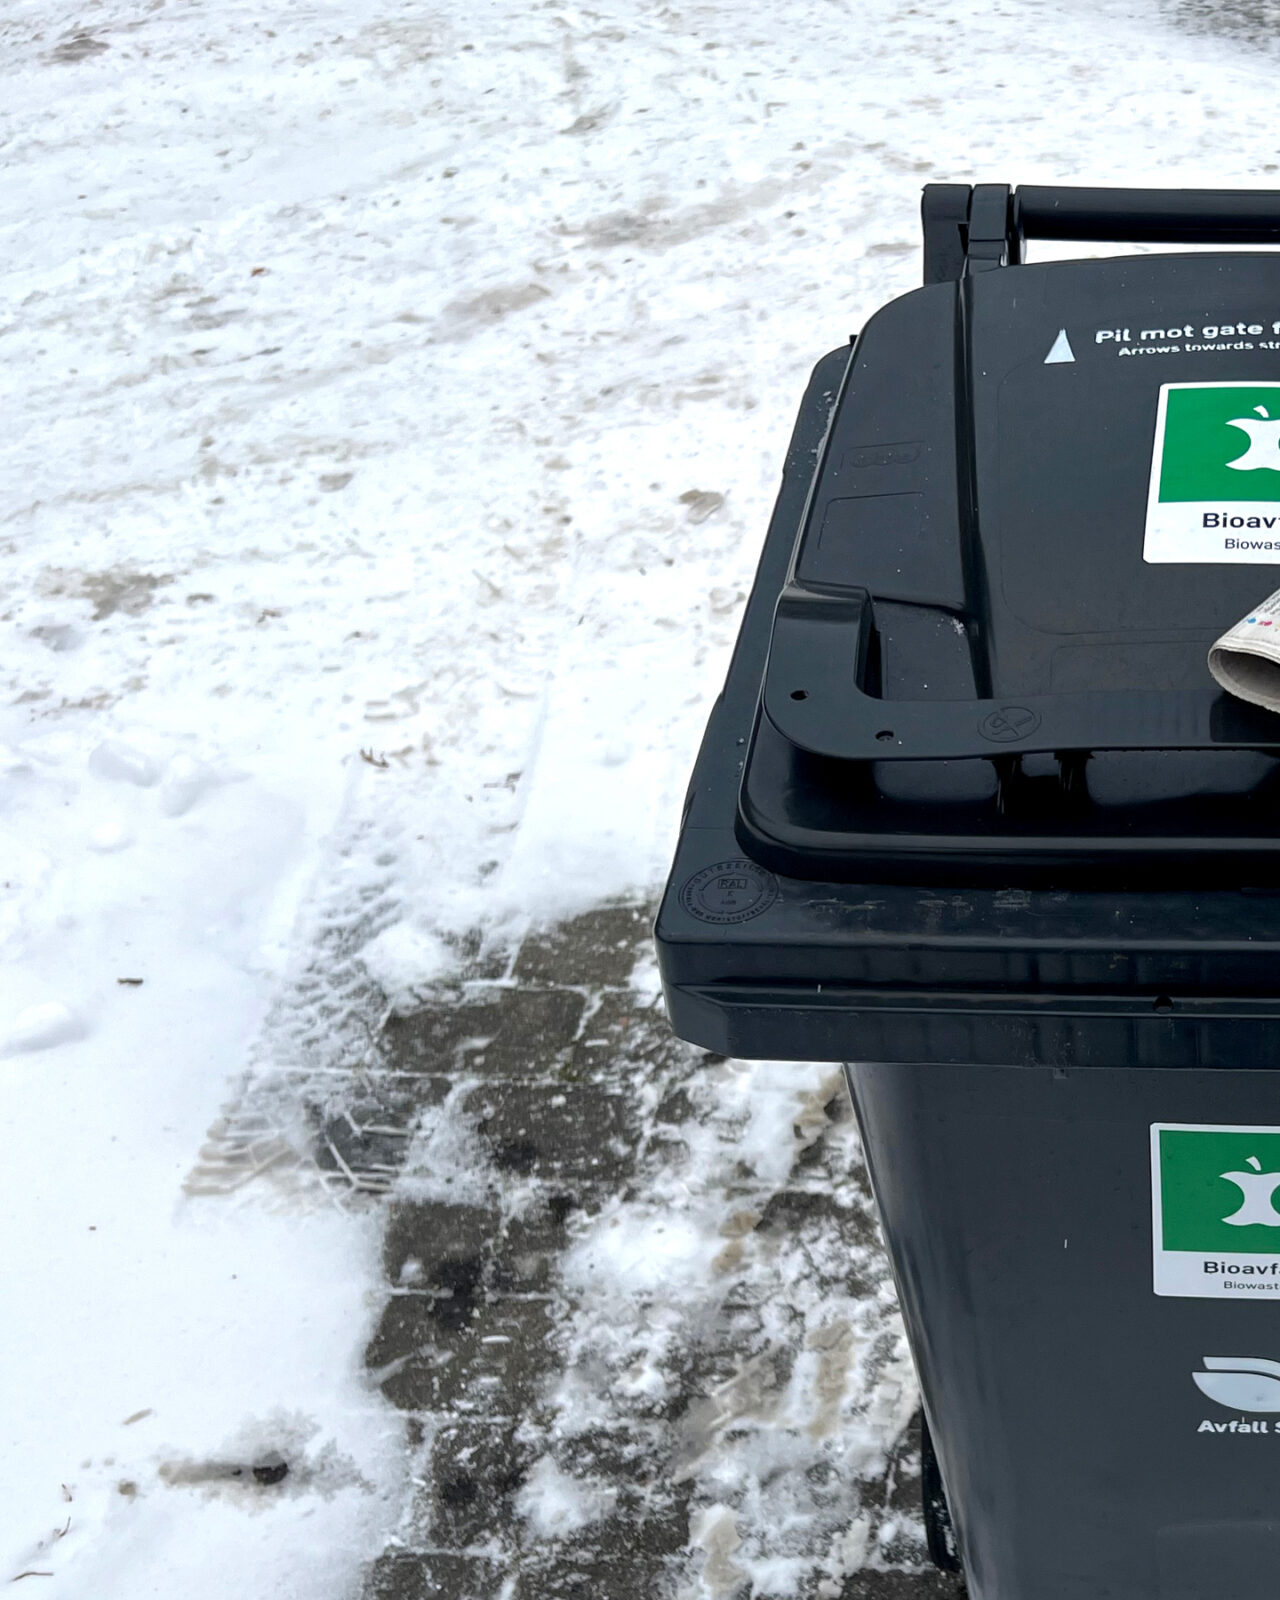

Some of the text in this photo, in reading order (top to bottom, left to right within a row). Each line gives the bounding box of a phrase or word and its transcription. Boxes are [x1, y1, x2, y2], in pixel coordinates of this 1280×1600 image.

[1095, 328, 1131, 343] Pil
[1140, 325, 1194, 341] mot
[1202, 324, 1263, 339] gate
[1118, 344, 1180, 357] Arrows
[1184, 341, 1254, 352] towards
[720, 879, 744, 889] RAL
[1196, 1417, 1269, 1434] Avfall
